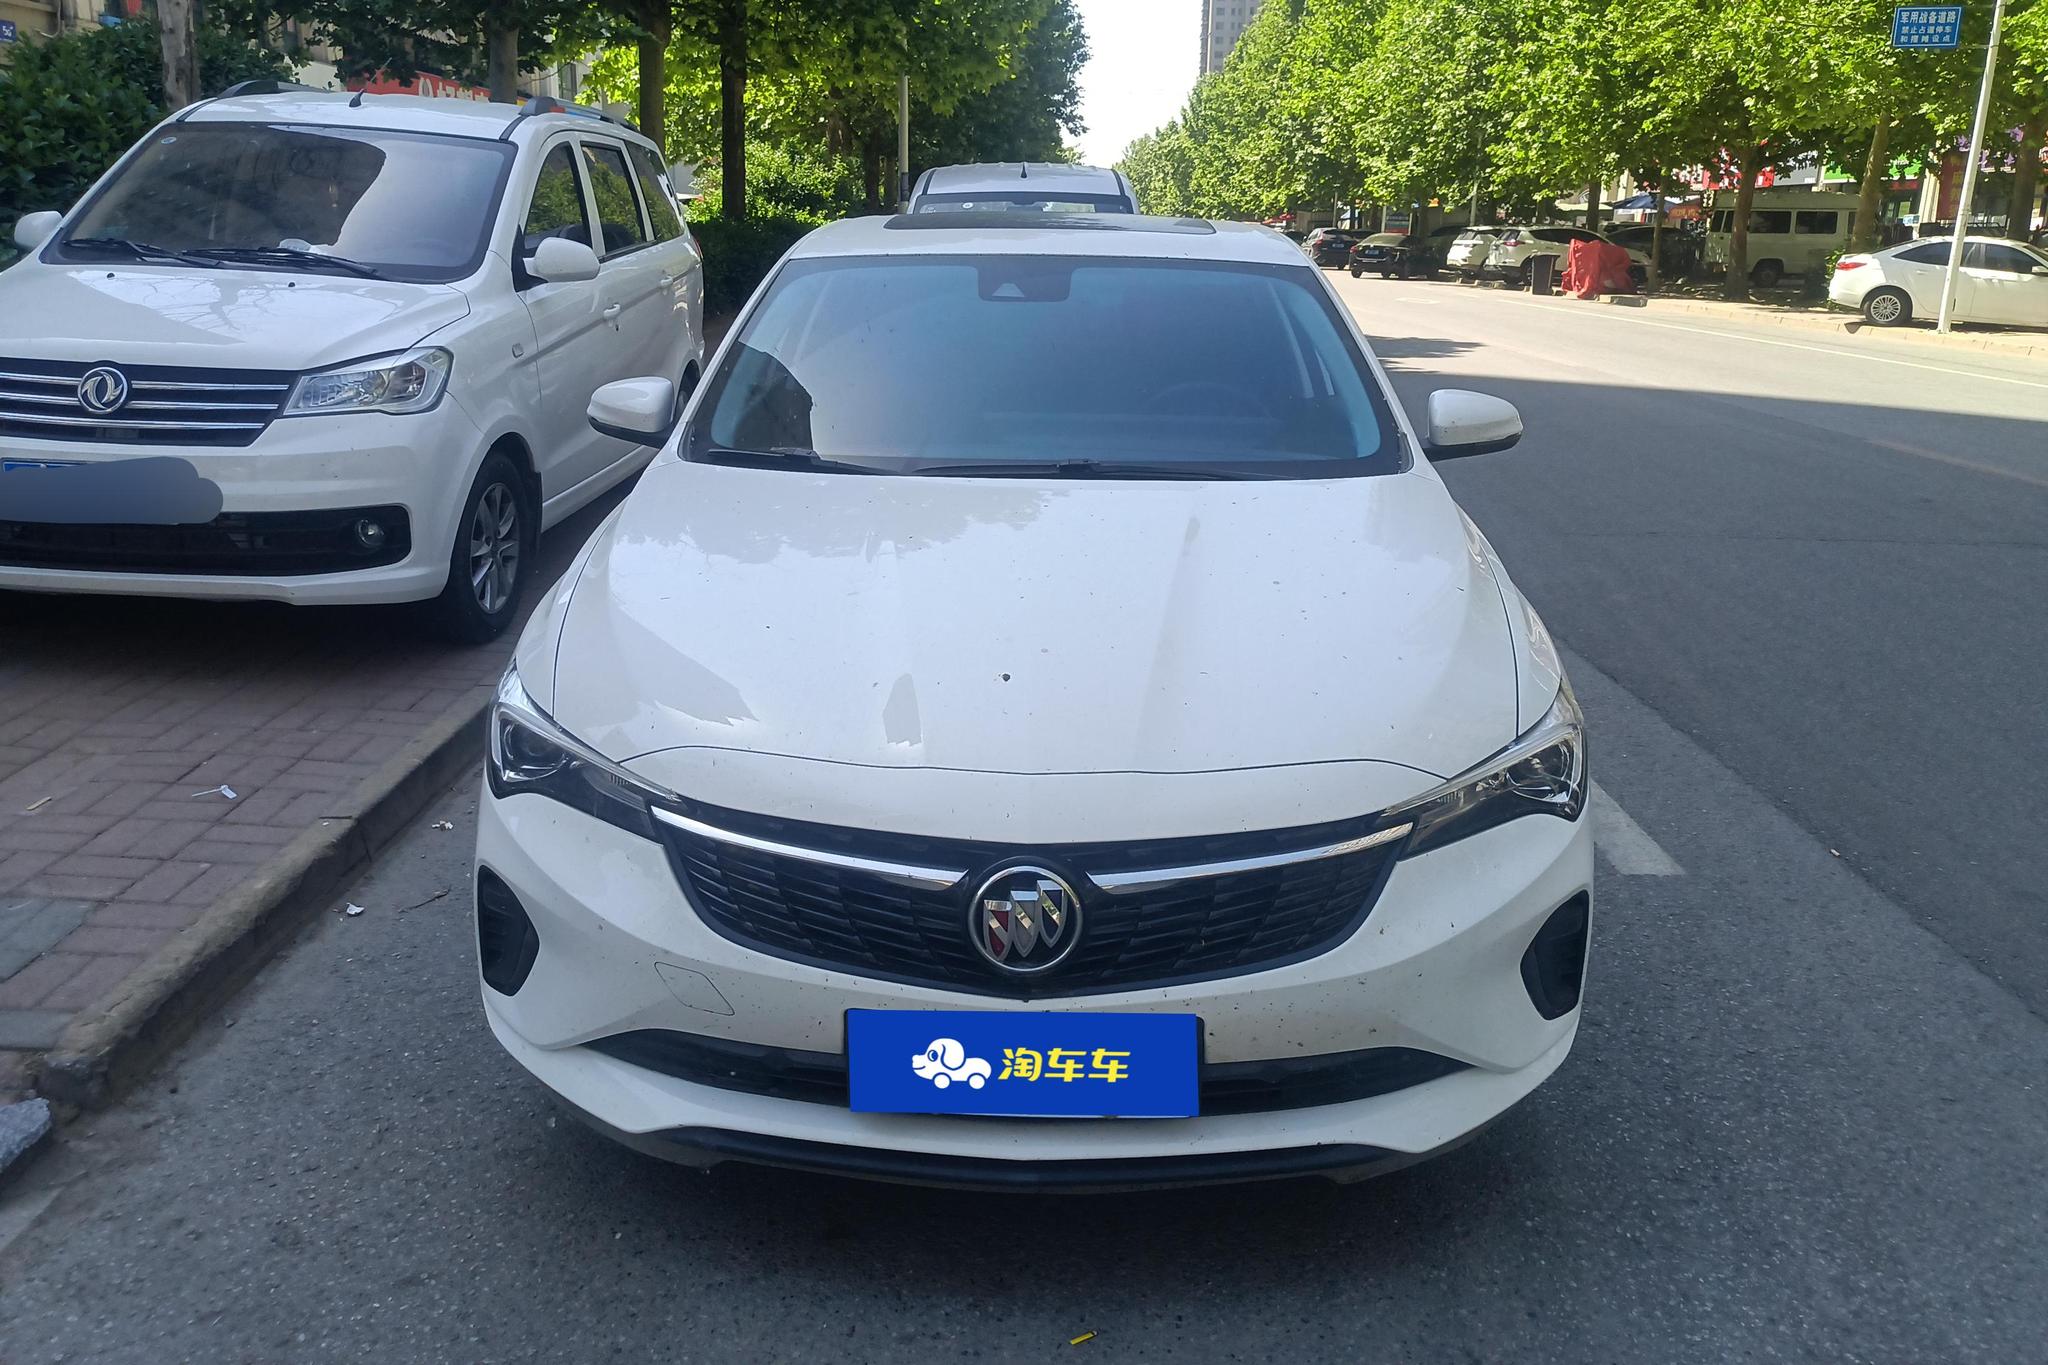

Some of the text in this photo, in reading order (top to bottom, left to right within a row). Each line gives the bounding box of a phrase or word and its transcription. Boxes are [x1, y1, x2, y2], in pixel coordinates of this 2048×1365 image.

[1900, 11, 1956, 23] 军用战备道路
[1901, 26, 1952, 34] 禁止占道停车
